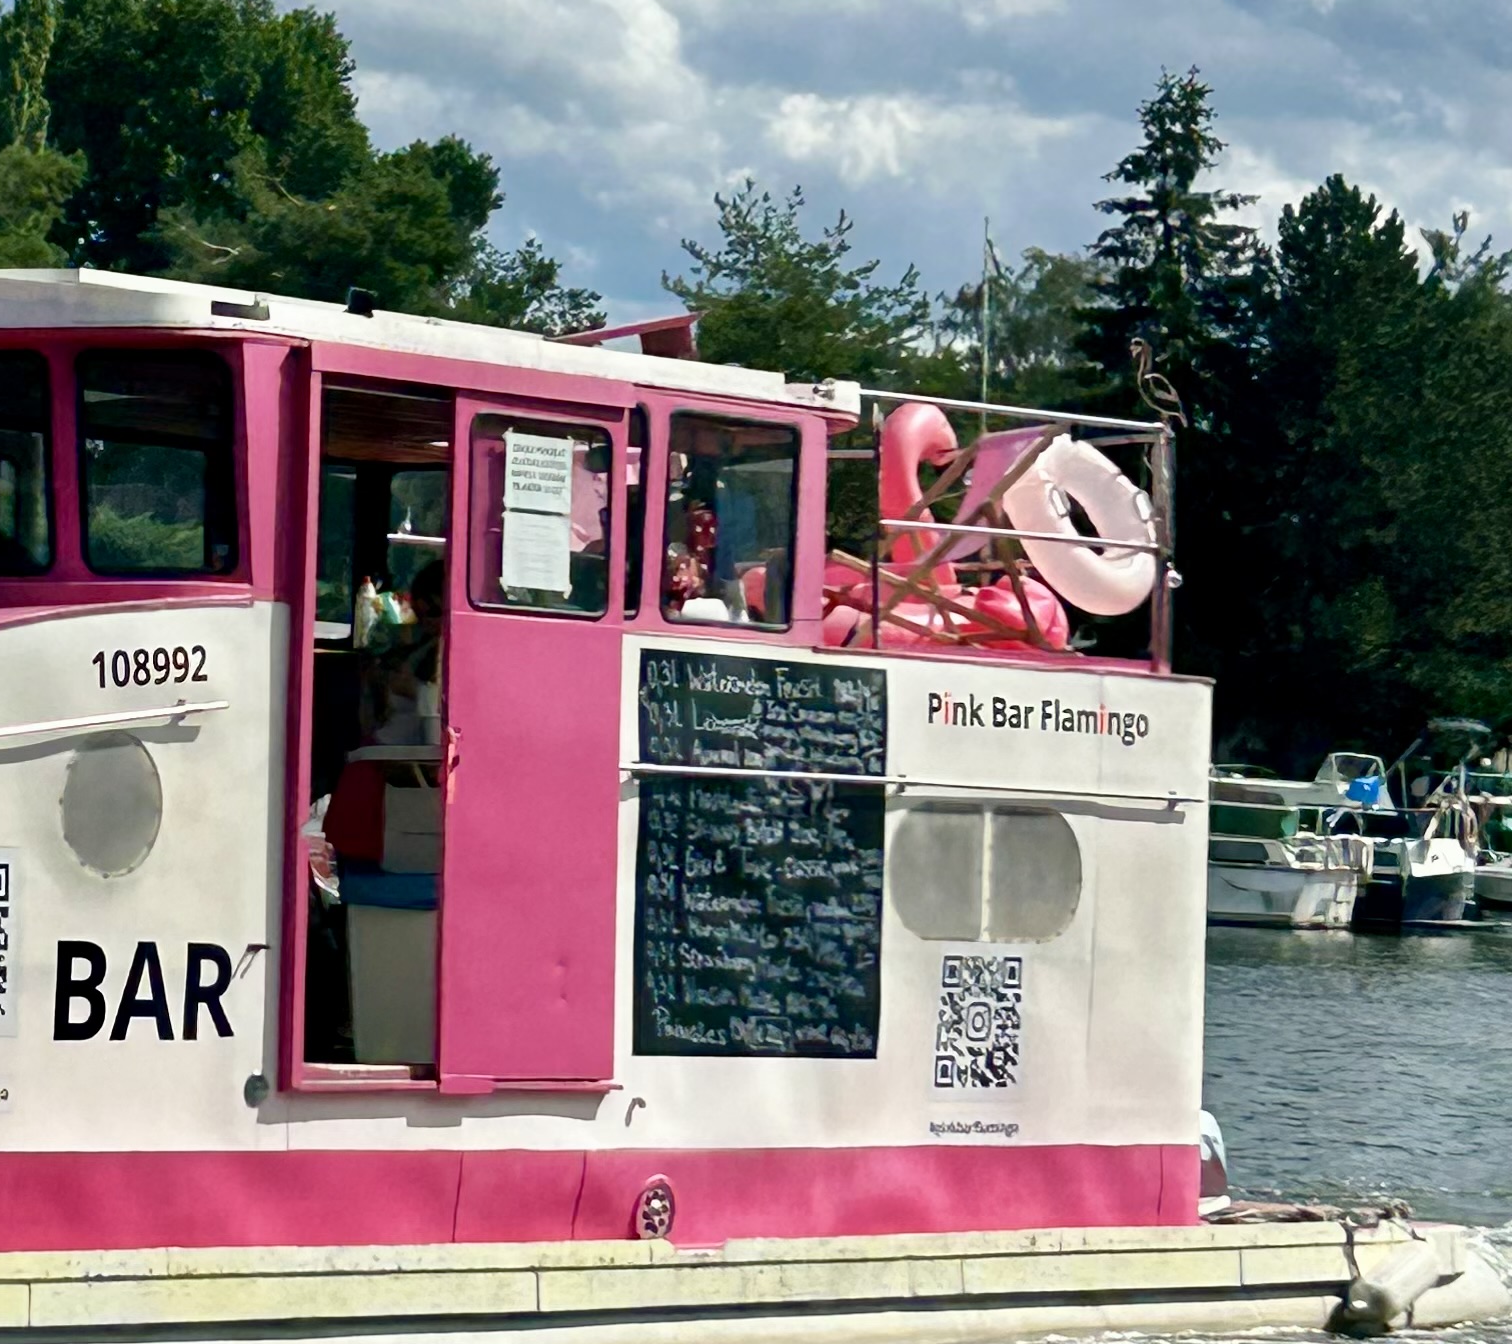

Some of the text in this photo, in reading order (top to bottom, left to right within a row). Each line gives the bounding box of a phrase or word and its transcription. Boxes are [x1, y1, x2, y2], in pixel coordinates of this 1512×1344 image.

[92, 644, 208, 689] 108992
[927, 692, 1149, 747] Pink Bar Flamingo
[54, 940, 235, 1042] BAR
